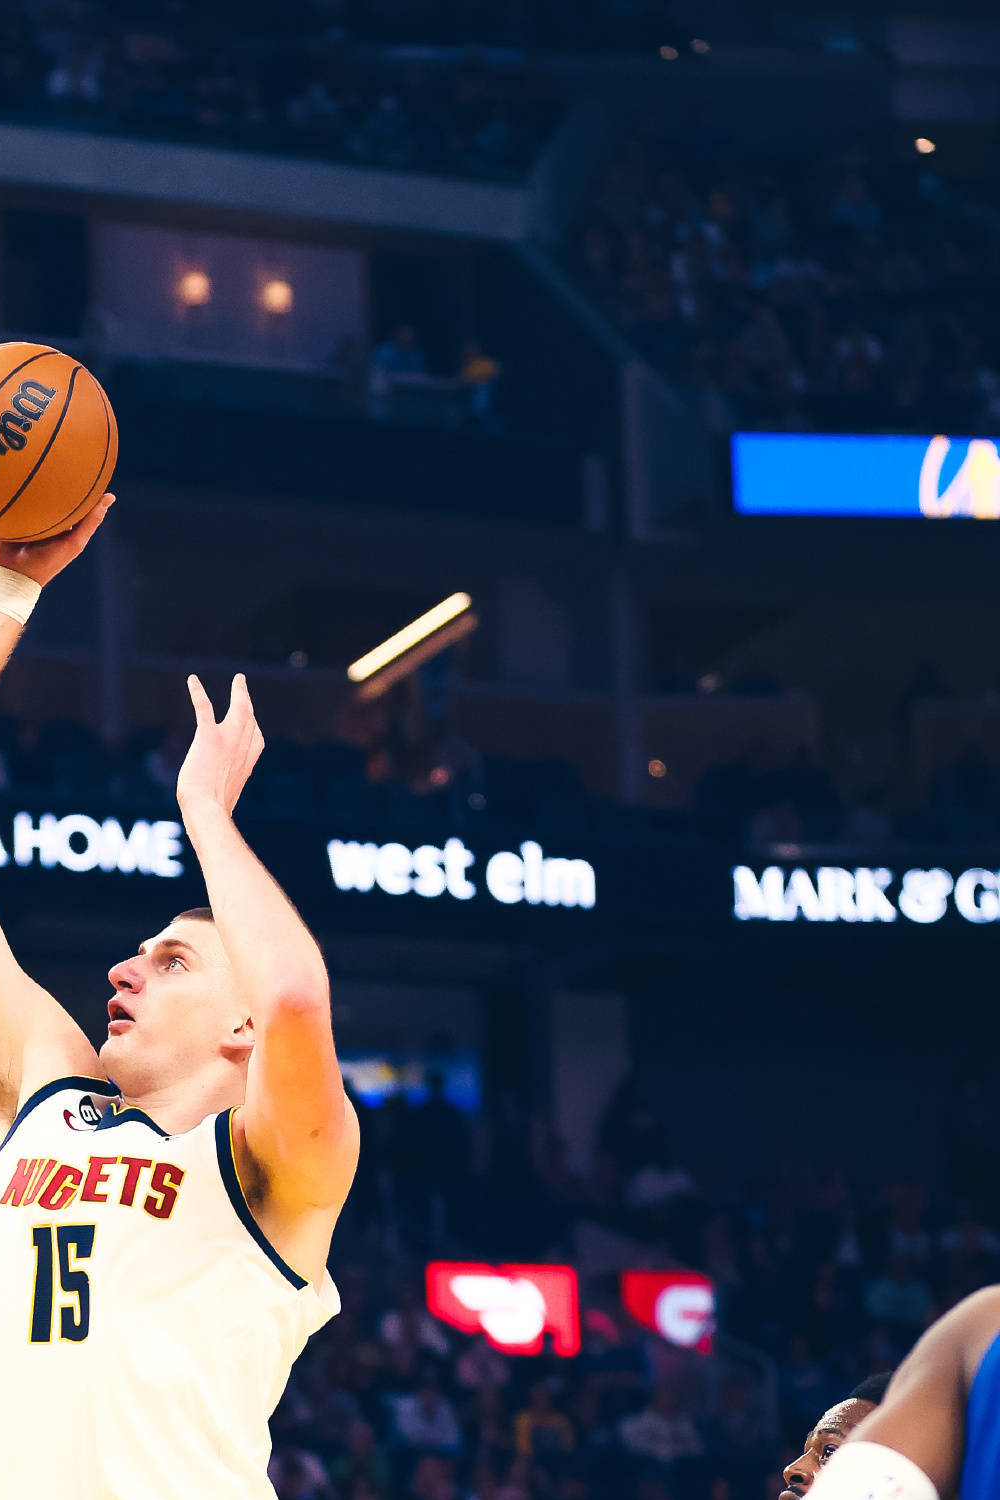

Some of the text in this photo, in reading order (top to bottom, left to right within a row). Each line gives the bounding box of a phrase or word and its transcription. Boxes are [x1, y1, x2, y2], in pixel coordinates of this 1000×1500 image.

[13, 810, 185, 878] HOME
[327, 837, 596, 910] west elm
[732, 865, 1000, 923] MARK & G
[29, 1223, 97, 1343] 15
